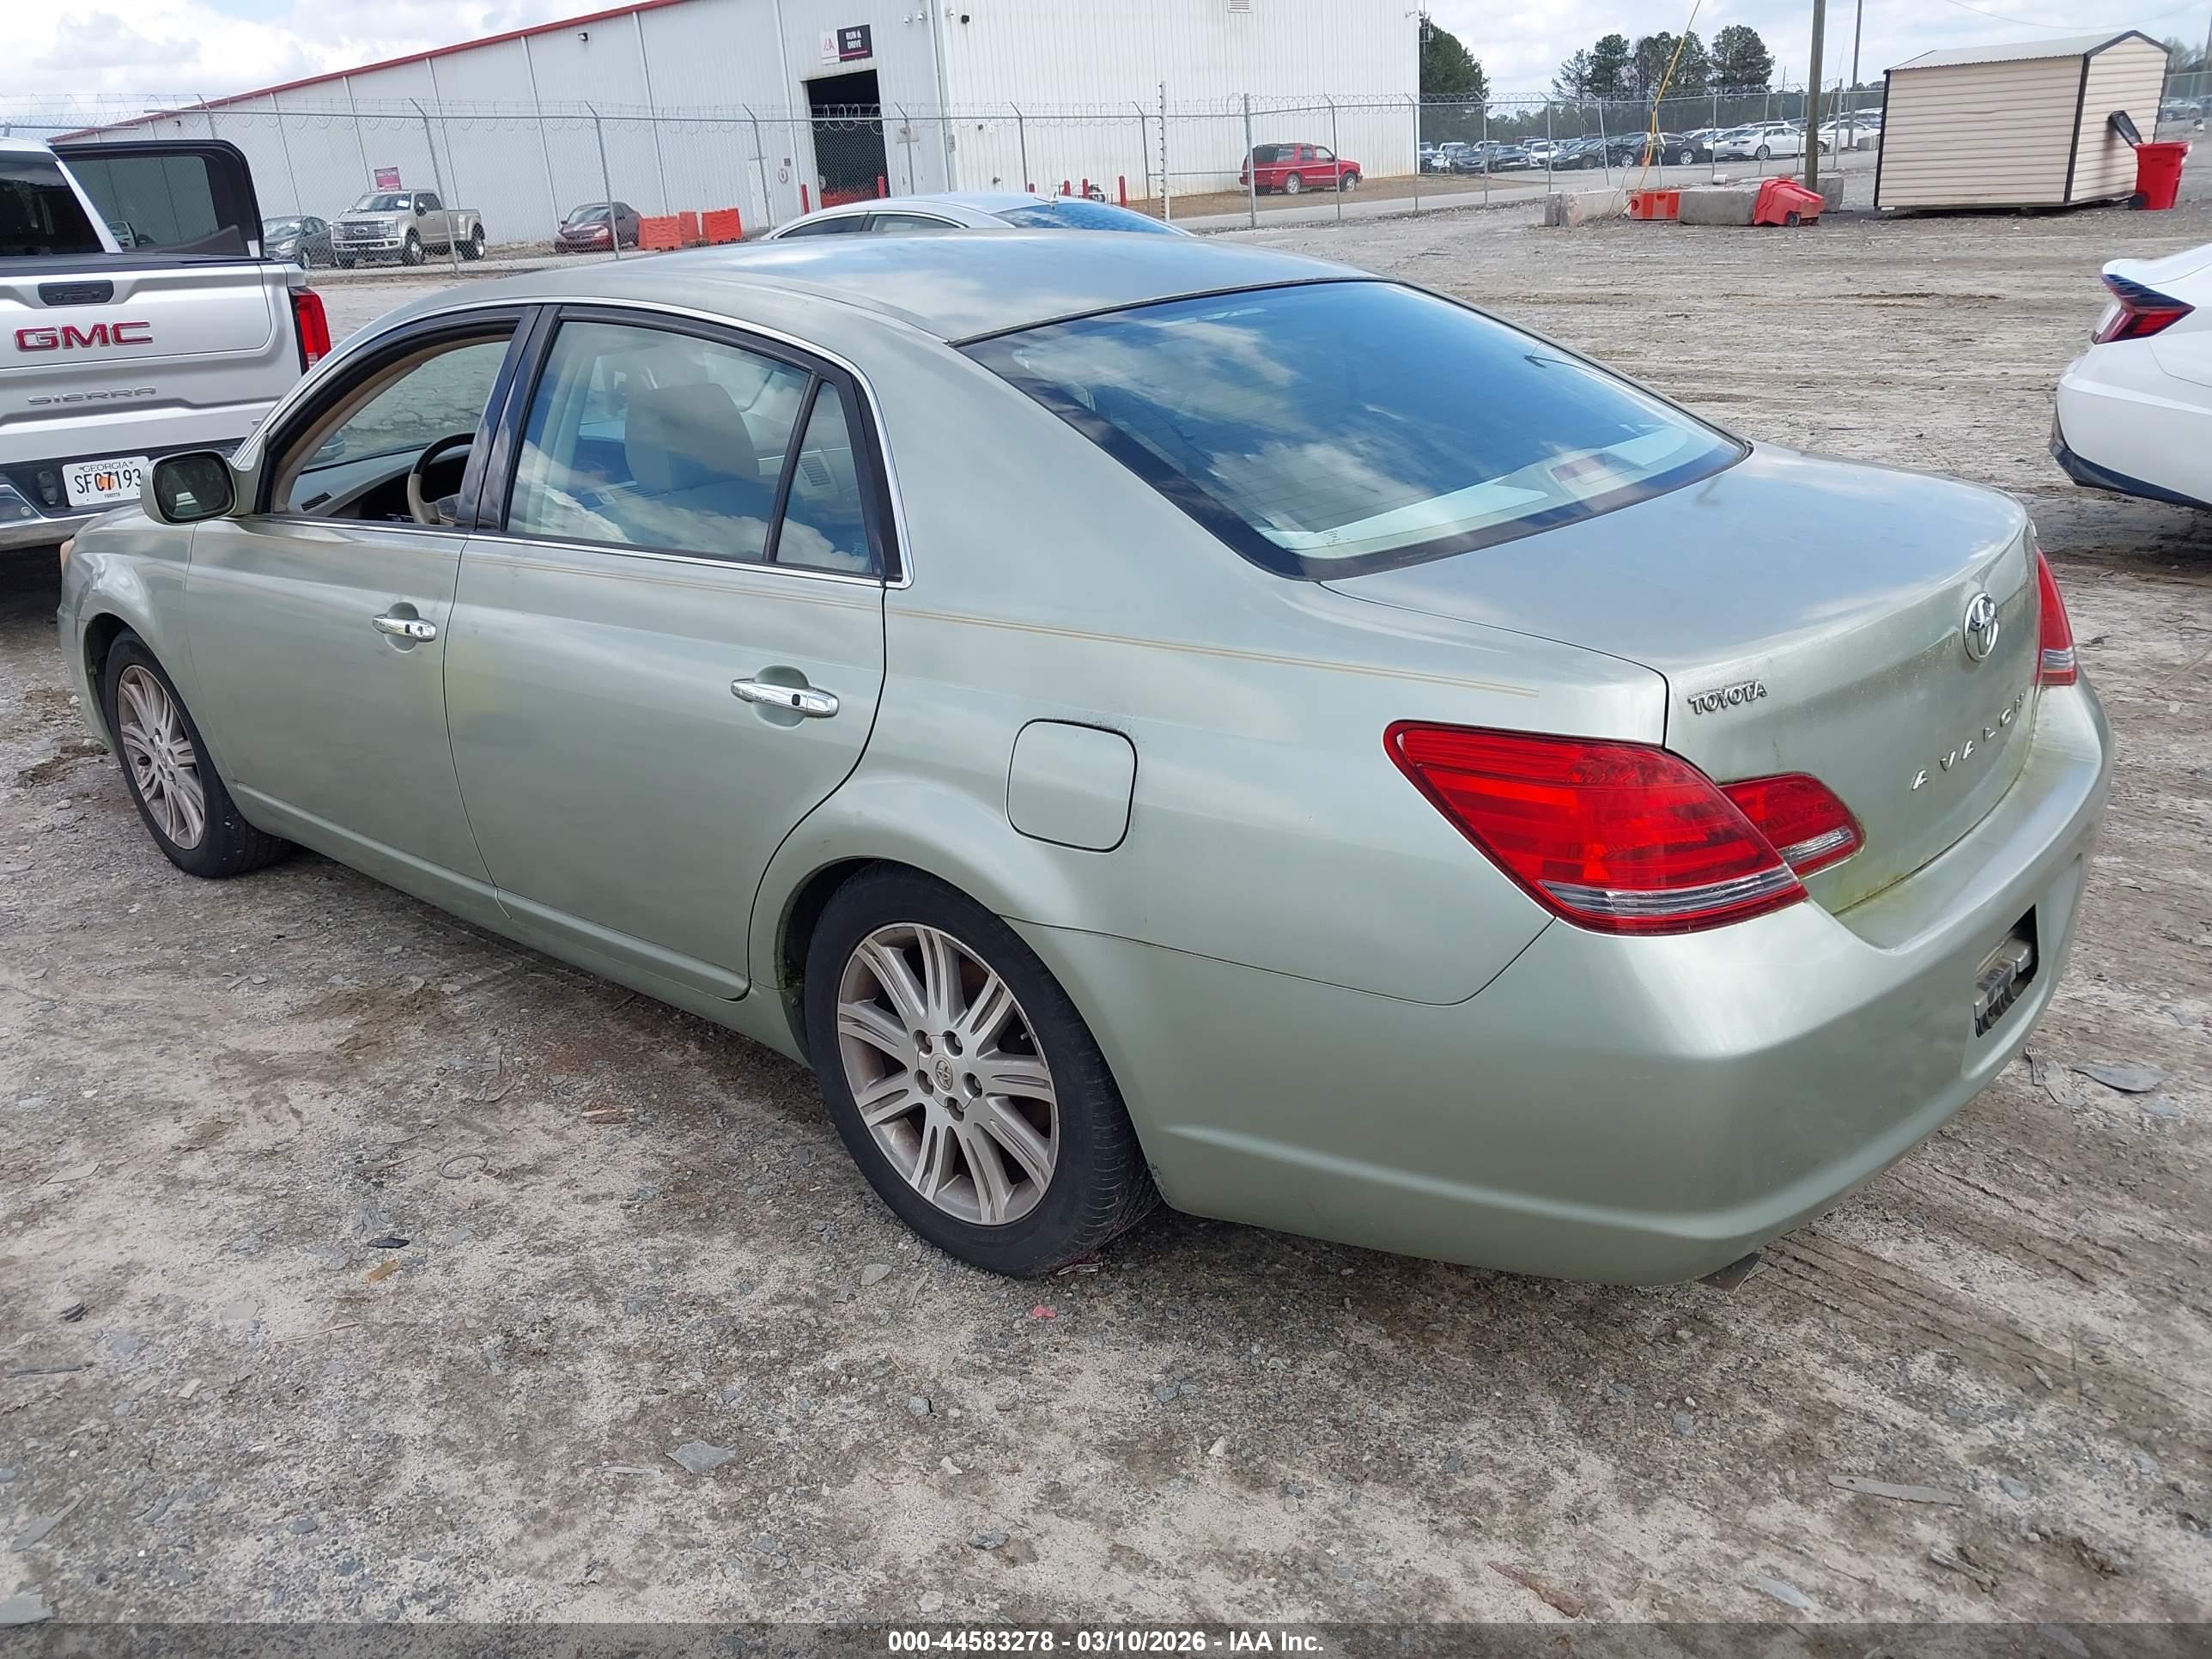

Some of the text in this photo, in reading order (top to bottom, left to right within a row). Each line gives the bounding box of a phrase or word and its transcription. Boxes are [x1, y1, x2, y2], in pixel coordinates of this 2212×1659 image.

[14, 320, 154, 352] GMC
[27, 386, 156, 405] SIERRA
[82, 461, 129, 472] GEORGIA
[74, 468, 142, 494] SFC7193
[1687, 679, 1768, 714] TOYOTA
